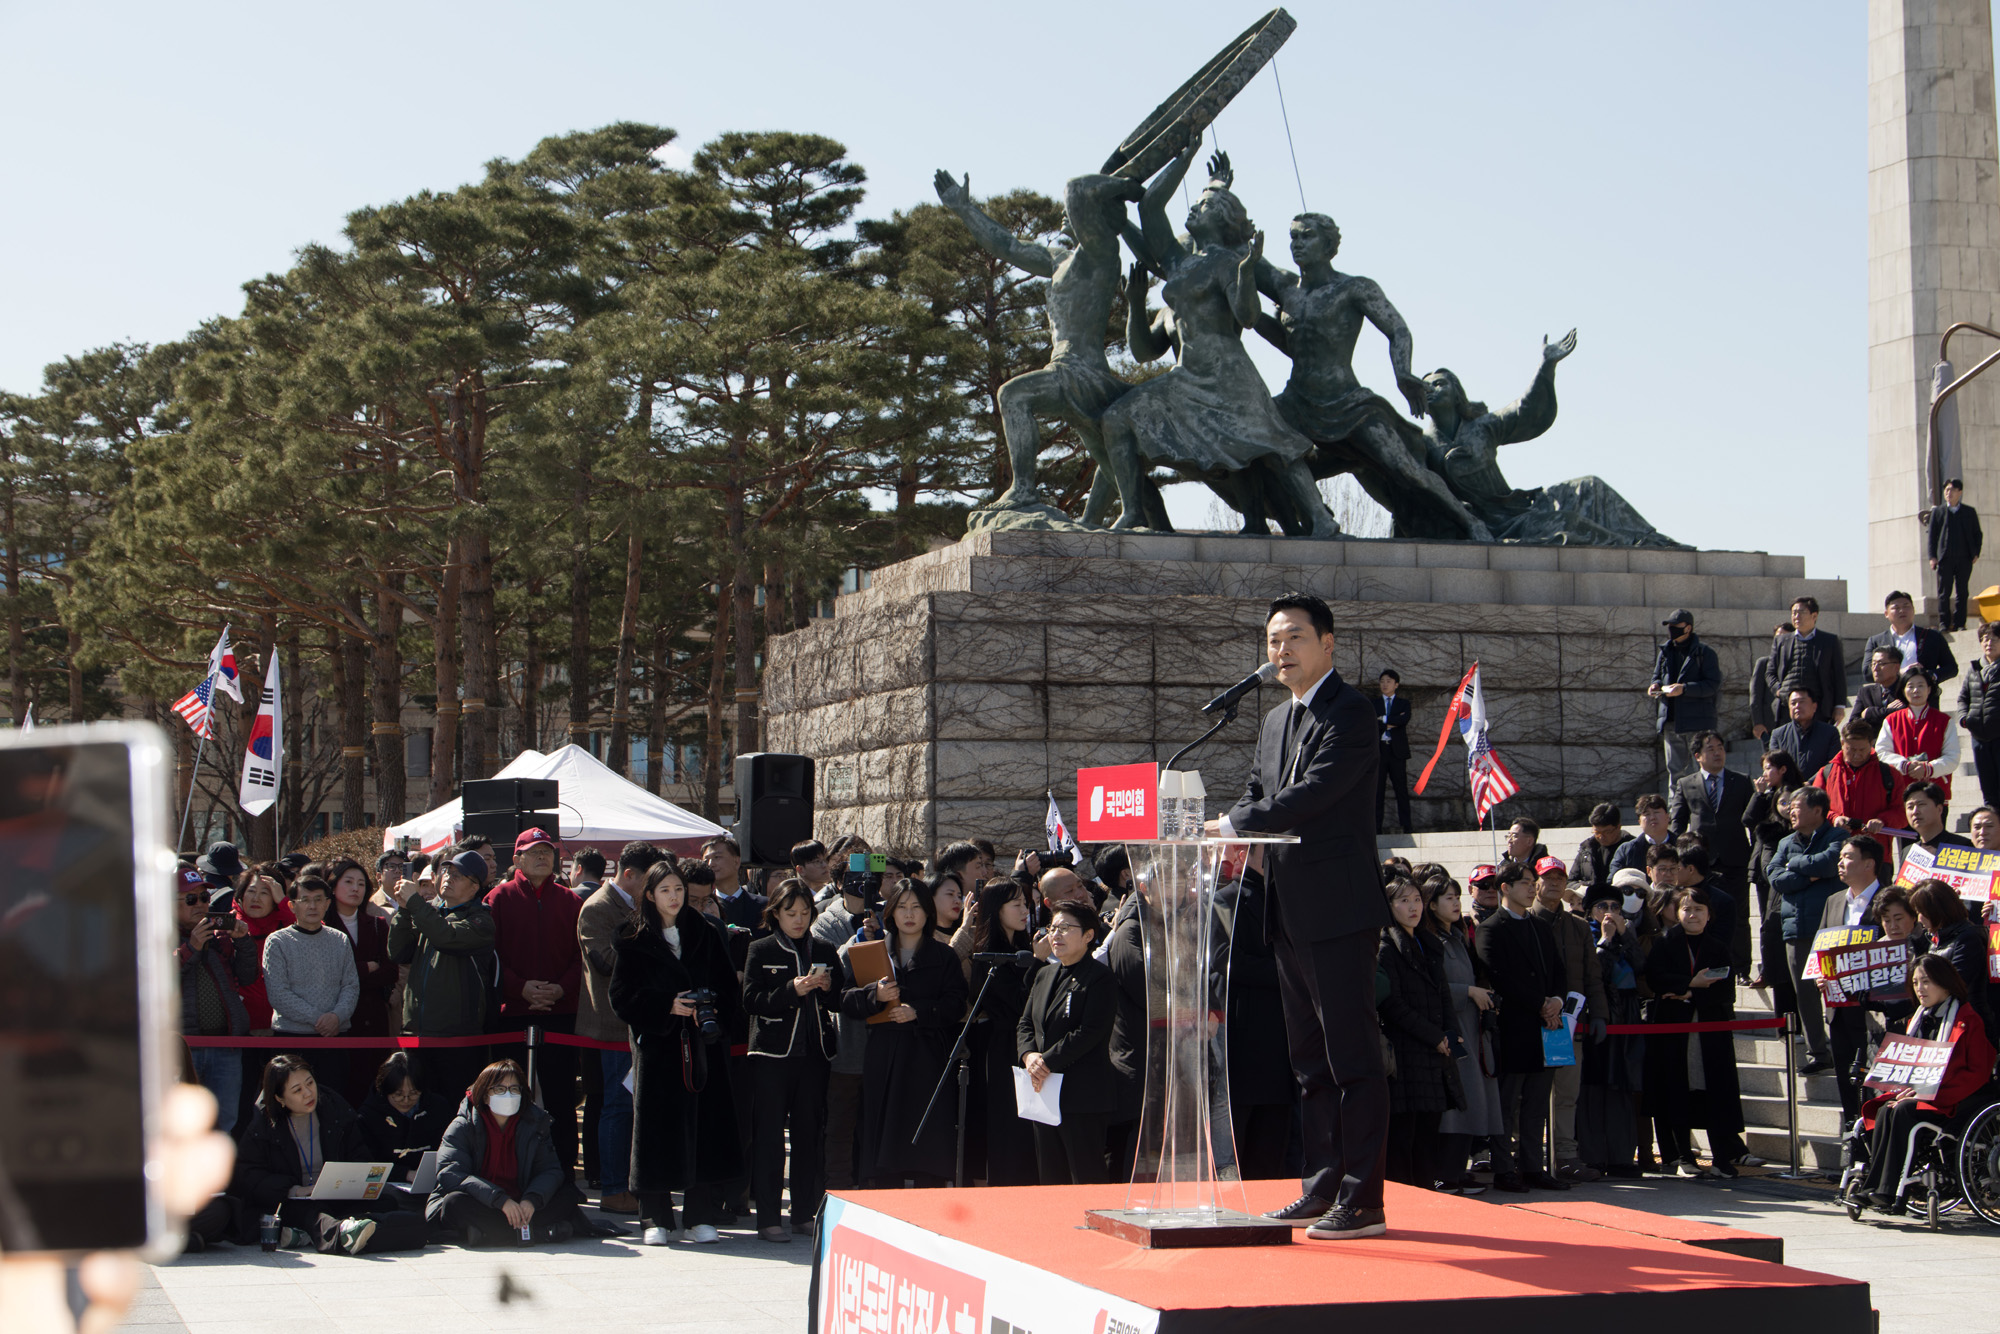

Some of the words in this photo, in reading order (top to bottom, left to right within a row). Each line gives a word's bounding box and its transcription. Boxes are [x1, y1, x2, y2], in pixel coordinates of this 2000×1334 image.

[1106, 788, 1145, 817] 국민의힘
[1936, 847, 1981, 871] 삼권분립
[1813, 929, 1849, 951] 삼권분립
[1849, 929, 1873, 946] 파괴
[1836, 950, 1867, 974] 사법
[1868, 944, 1906, 966] 파괴
[1839, 971, 1870, 994] 독재
[1870, 964, 1907, 988] 완성
[1880, 1041, 1921, 1063] 사법
[1917, 1047, 1952, 1064] 파괴
[1872, 1062, 1913, 1084] 독재
[1909, 1066, 1945, 1084] 완성
